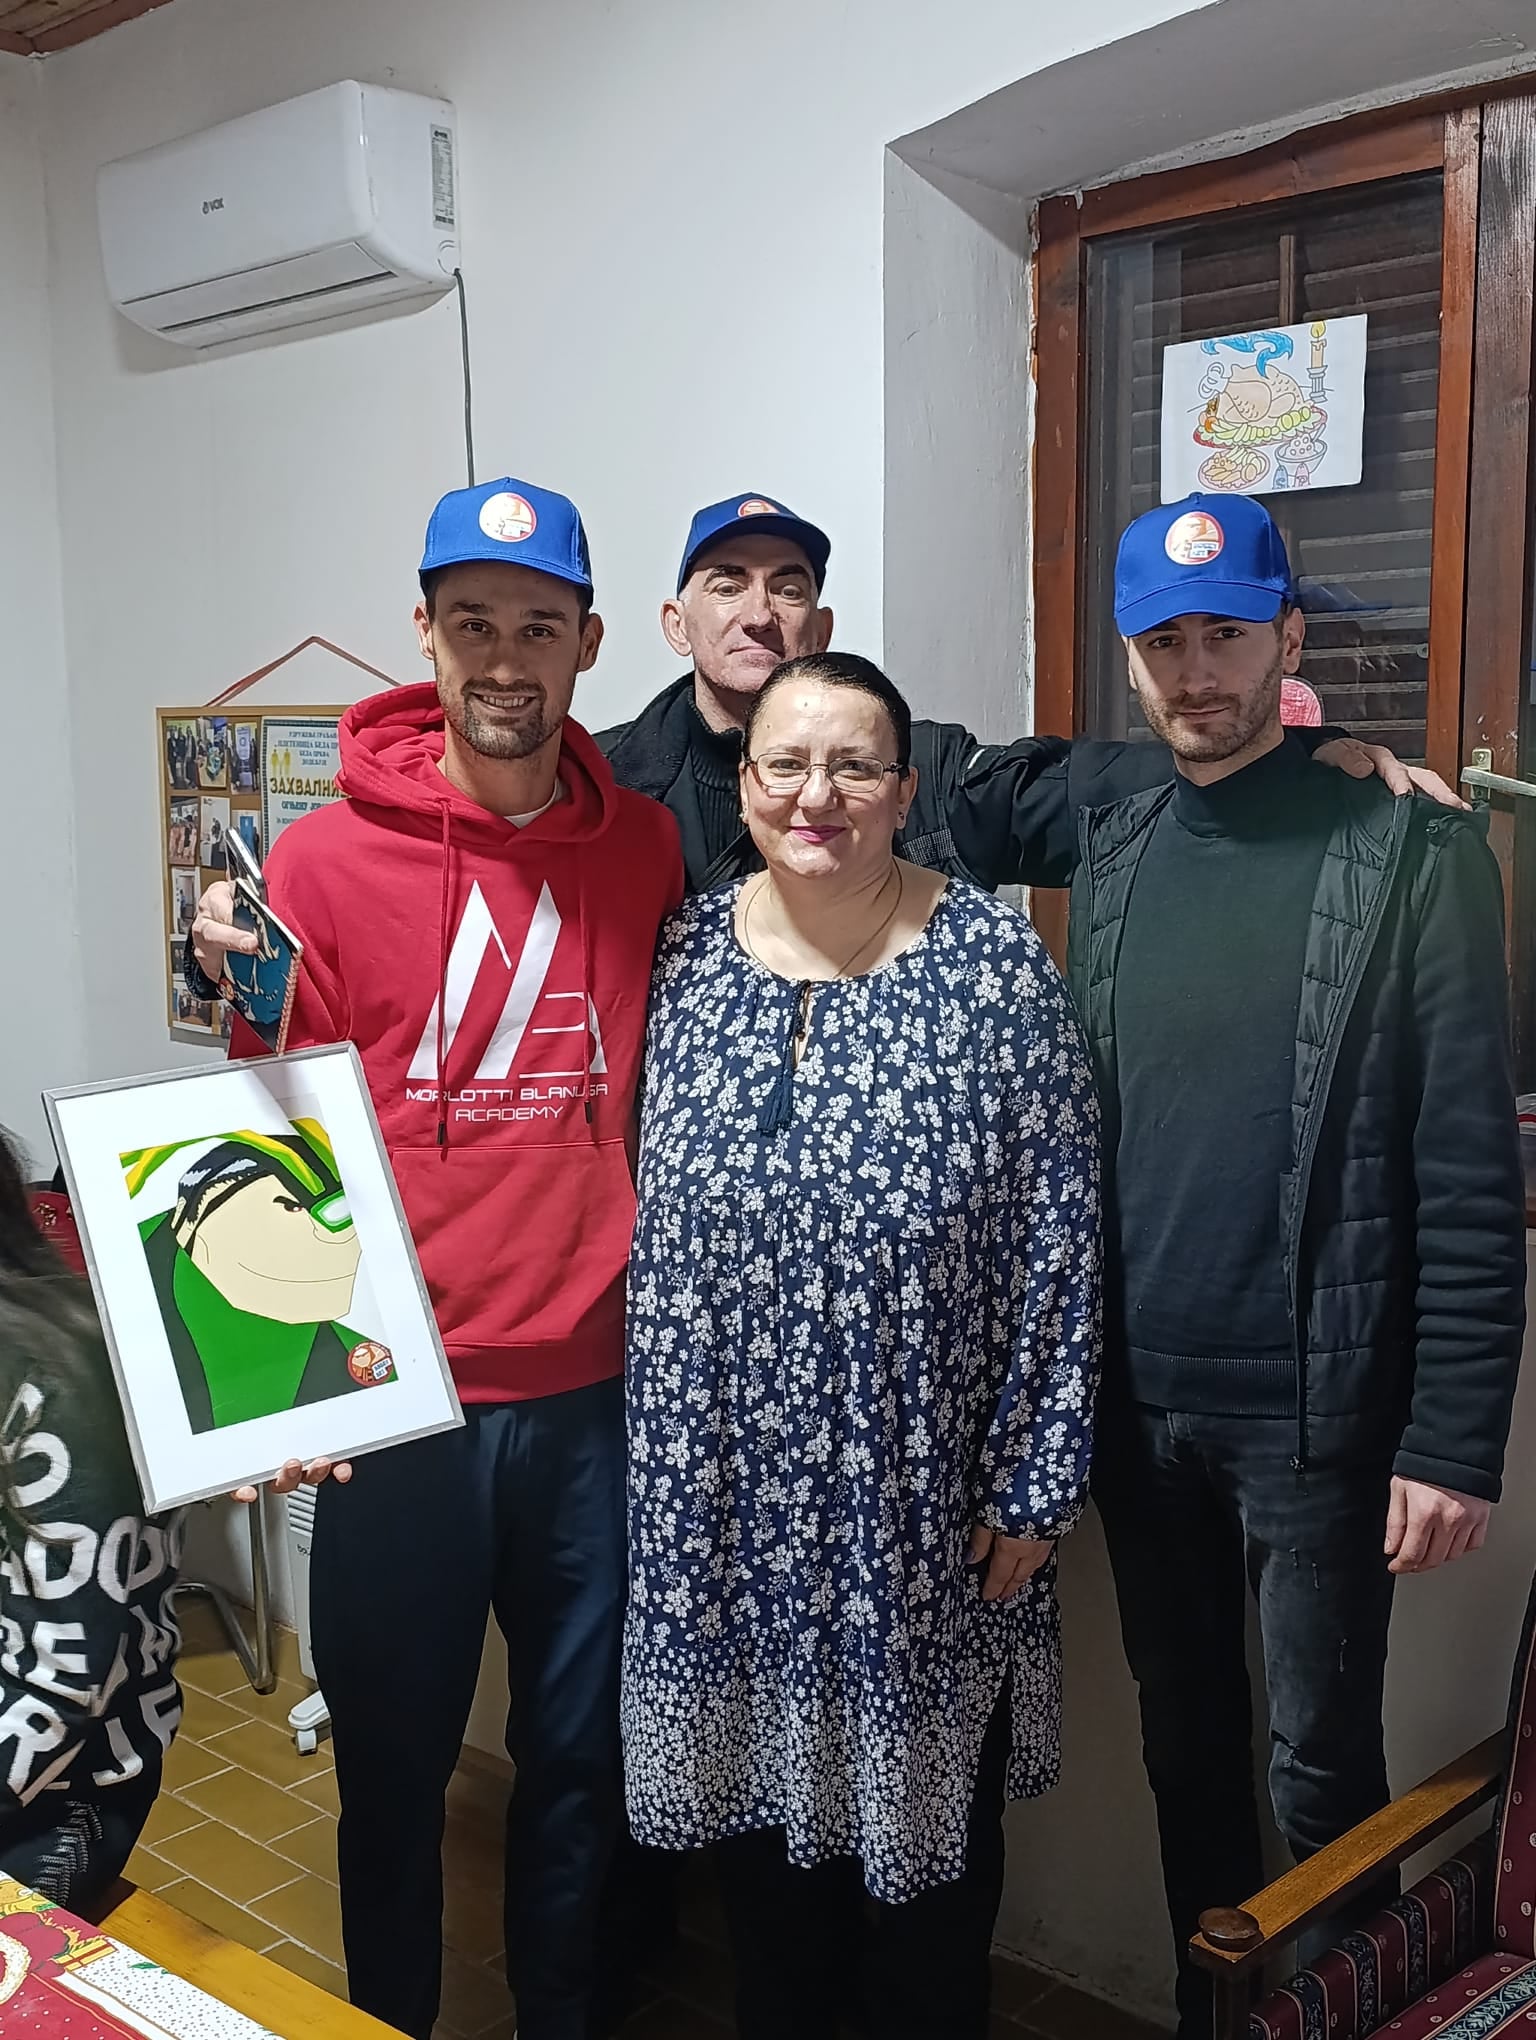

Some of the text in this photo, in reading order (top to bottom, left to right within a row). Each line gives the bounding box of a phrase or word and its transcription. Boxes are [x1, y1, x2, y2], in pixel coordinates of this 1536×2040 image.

[209, 197, 224, 211] VOX
[270, 777, 347, 798] ЗАХВАЛНИ
[455, 1105, 564, 1122] ACADEMY
